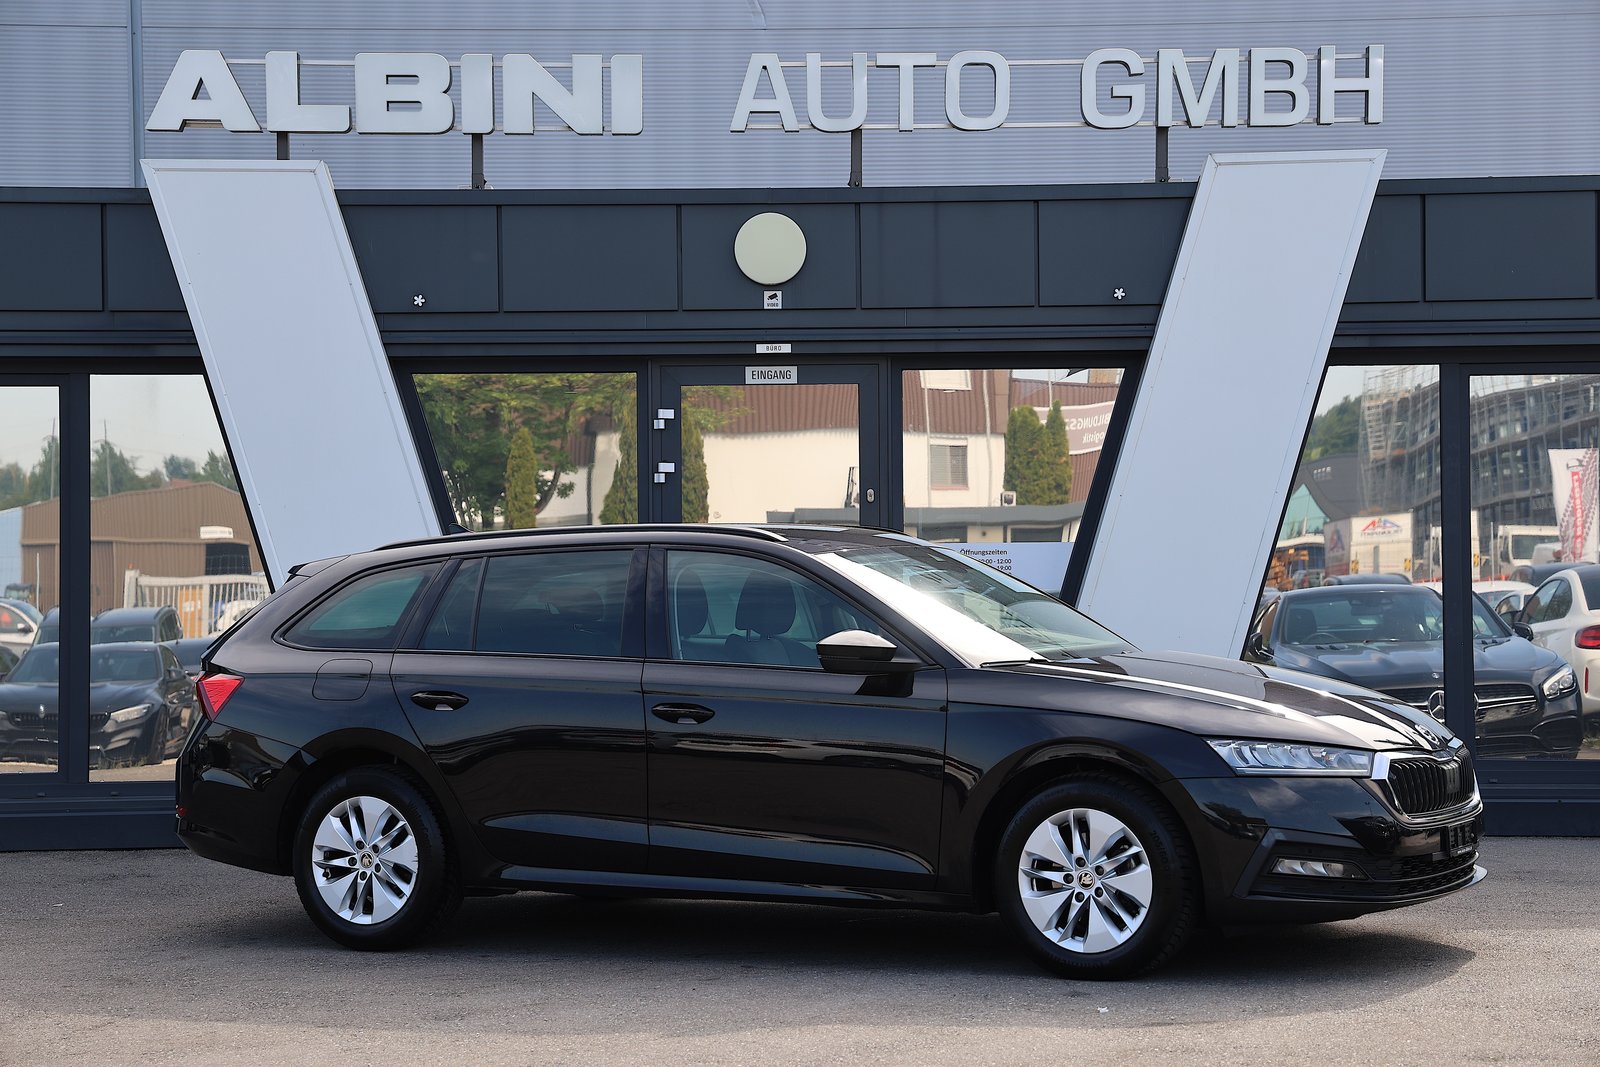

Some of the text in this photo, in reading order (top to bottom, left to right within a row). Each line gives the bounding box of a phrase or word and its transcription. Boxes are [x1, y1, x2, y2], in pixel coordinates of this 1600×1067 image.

[145, 44, 1385, 135] ALBINI AUTO GMBH
[751, 369, 792, 380] EINGANG
[960, 548, 1008, 556] Öffnungszeiten
